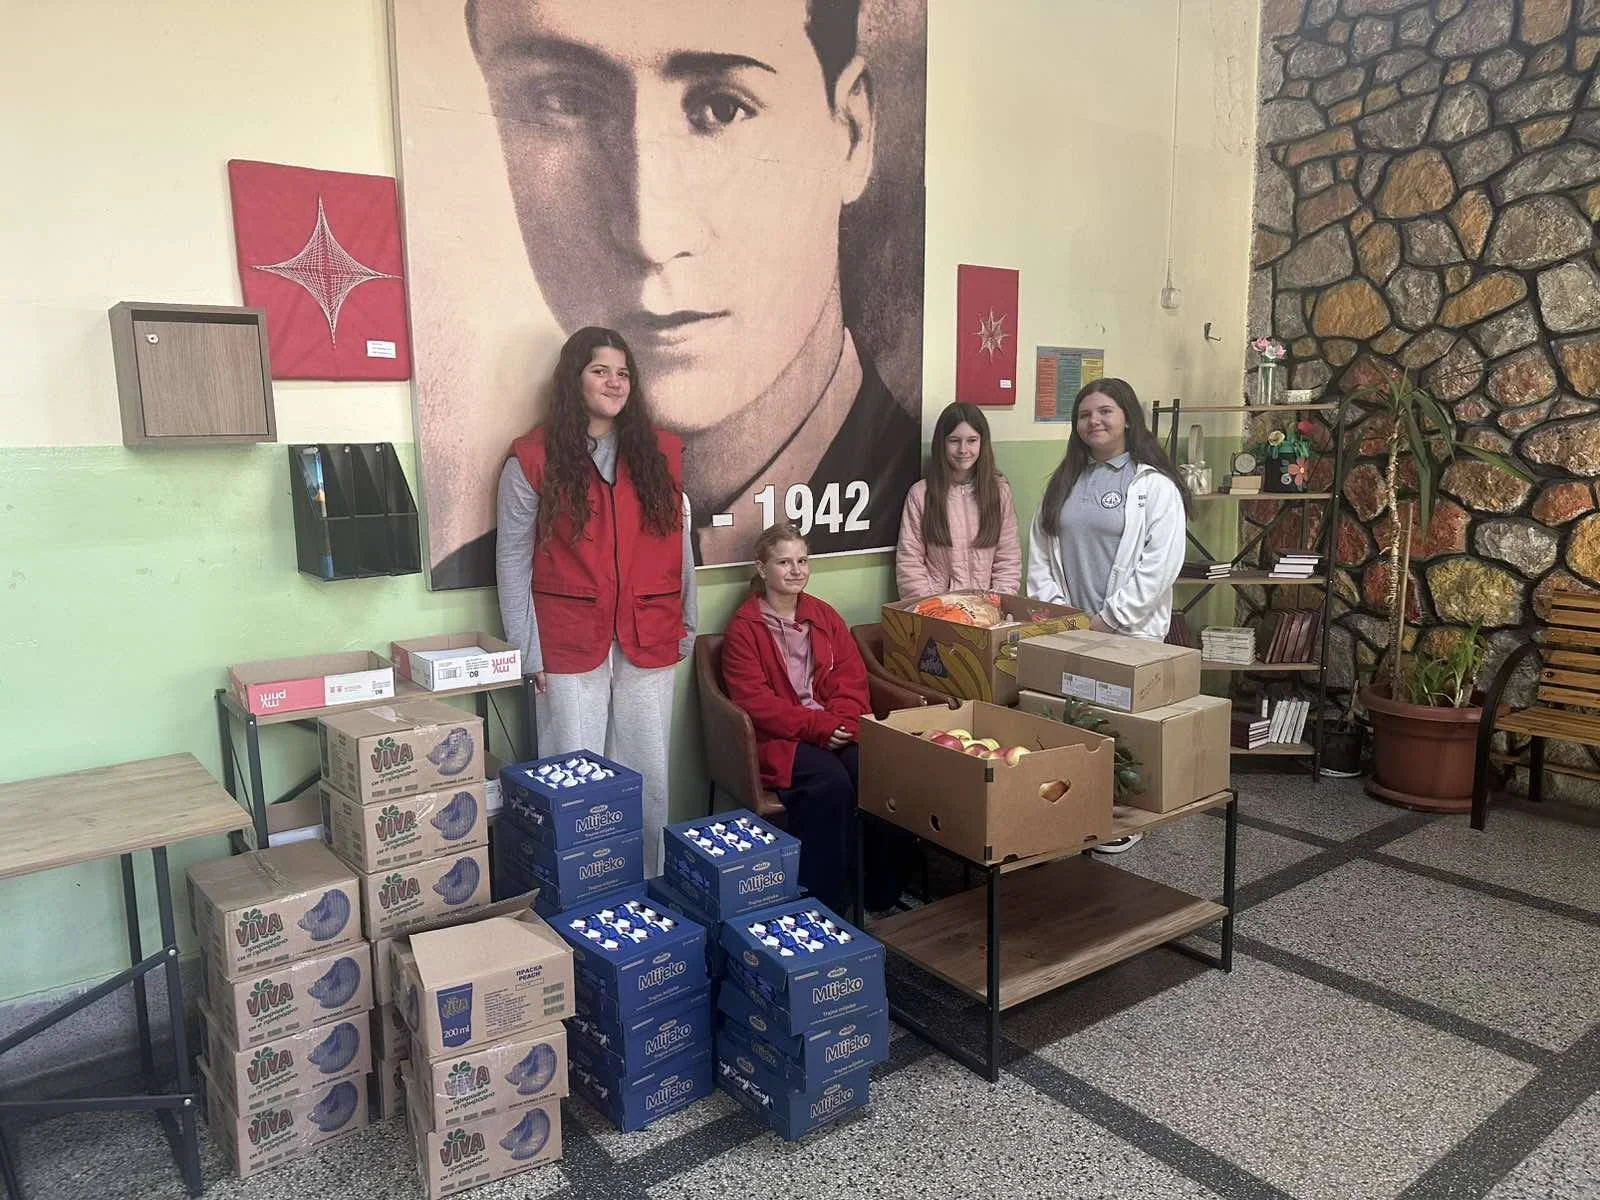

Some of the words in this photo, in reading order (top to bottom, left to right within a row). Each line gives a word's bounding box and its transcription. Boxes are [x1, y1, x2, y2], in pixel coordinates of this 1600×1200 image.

[754, 481, 871, 536] 1942
[491, 654, 516, 669] print
[492, 664, 510, 674] my
[259, 689, 287, 702] print
[261, 699, 280, 709] my
[371, 743, 414, 773] VIVA
[375, 810, 418, 841] VIVA
[576, 810, 623, 833] Mlijeko
[579, 856, 625, 880] Mlijeko
[738, 871, 785, 894] Mlijeko
[378, 877, 420, 909] VIVA
[236, 912, 284, 947] VIVA
[519, 971, 541, 981] PEACH
[638, 961, 687, 991] Mlijeko
[812, 977, 864, 1004] Mlijeko
[247, 982, 294, 1017] VIVA
[443, 1028, 459, 1039] 200
[459, 1024, 470, 1034] ml
[645, 1023, 692, 1055] Mlijeko
[825, 1033, 871, 1063] Mlijeko
[247, 1049, 294, 1085] VIVA
[646, 1079, 693, 1110] Mlijeko
[810, 1088, 854, 1118] Mlijeko
[248, 1109, 294, 1145] VIVA
[440, 1132, 485, 1167] VIVA
